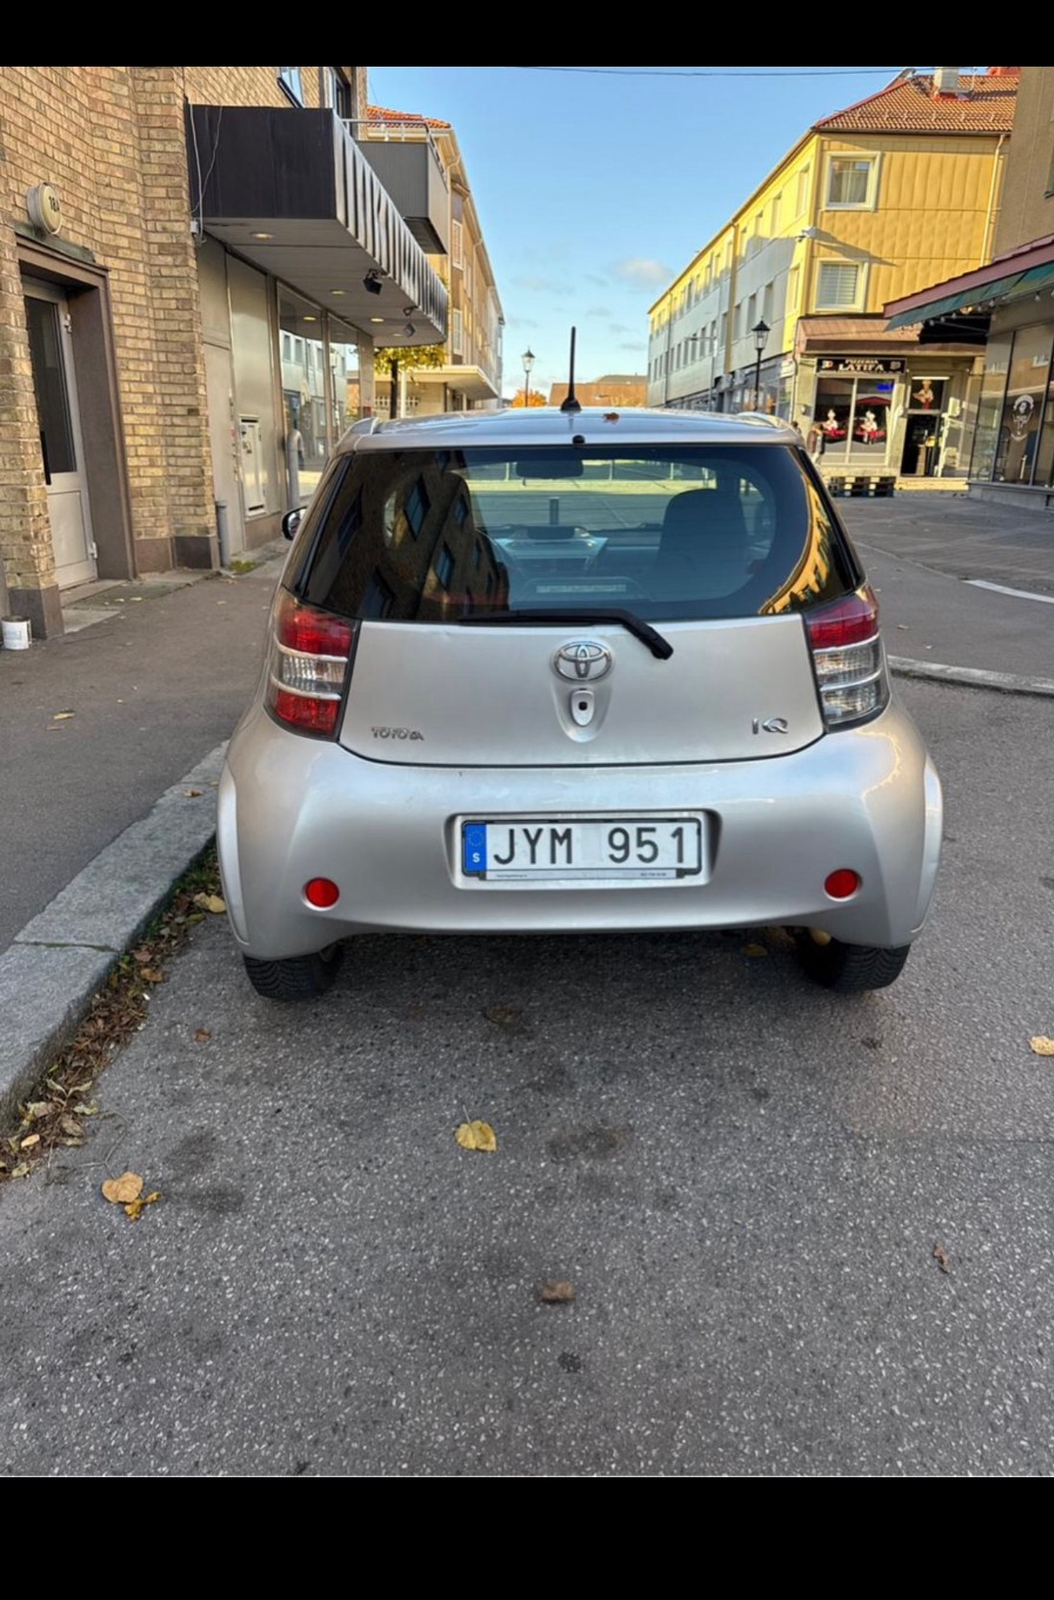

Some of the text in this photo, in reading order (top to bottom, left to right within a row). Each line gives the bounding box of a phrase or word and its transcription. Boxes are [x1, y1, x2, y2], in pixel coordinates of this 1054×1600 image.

[472, 852, 481, 864] S
[493, 826, 685, 865] JYM 951
